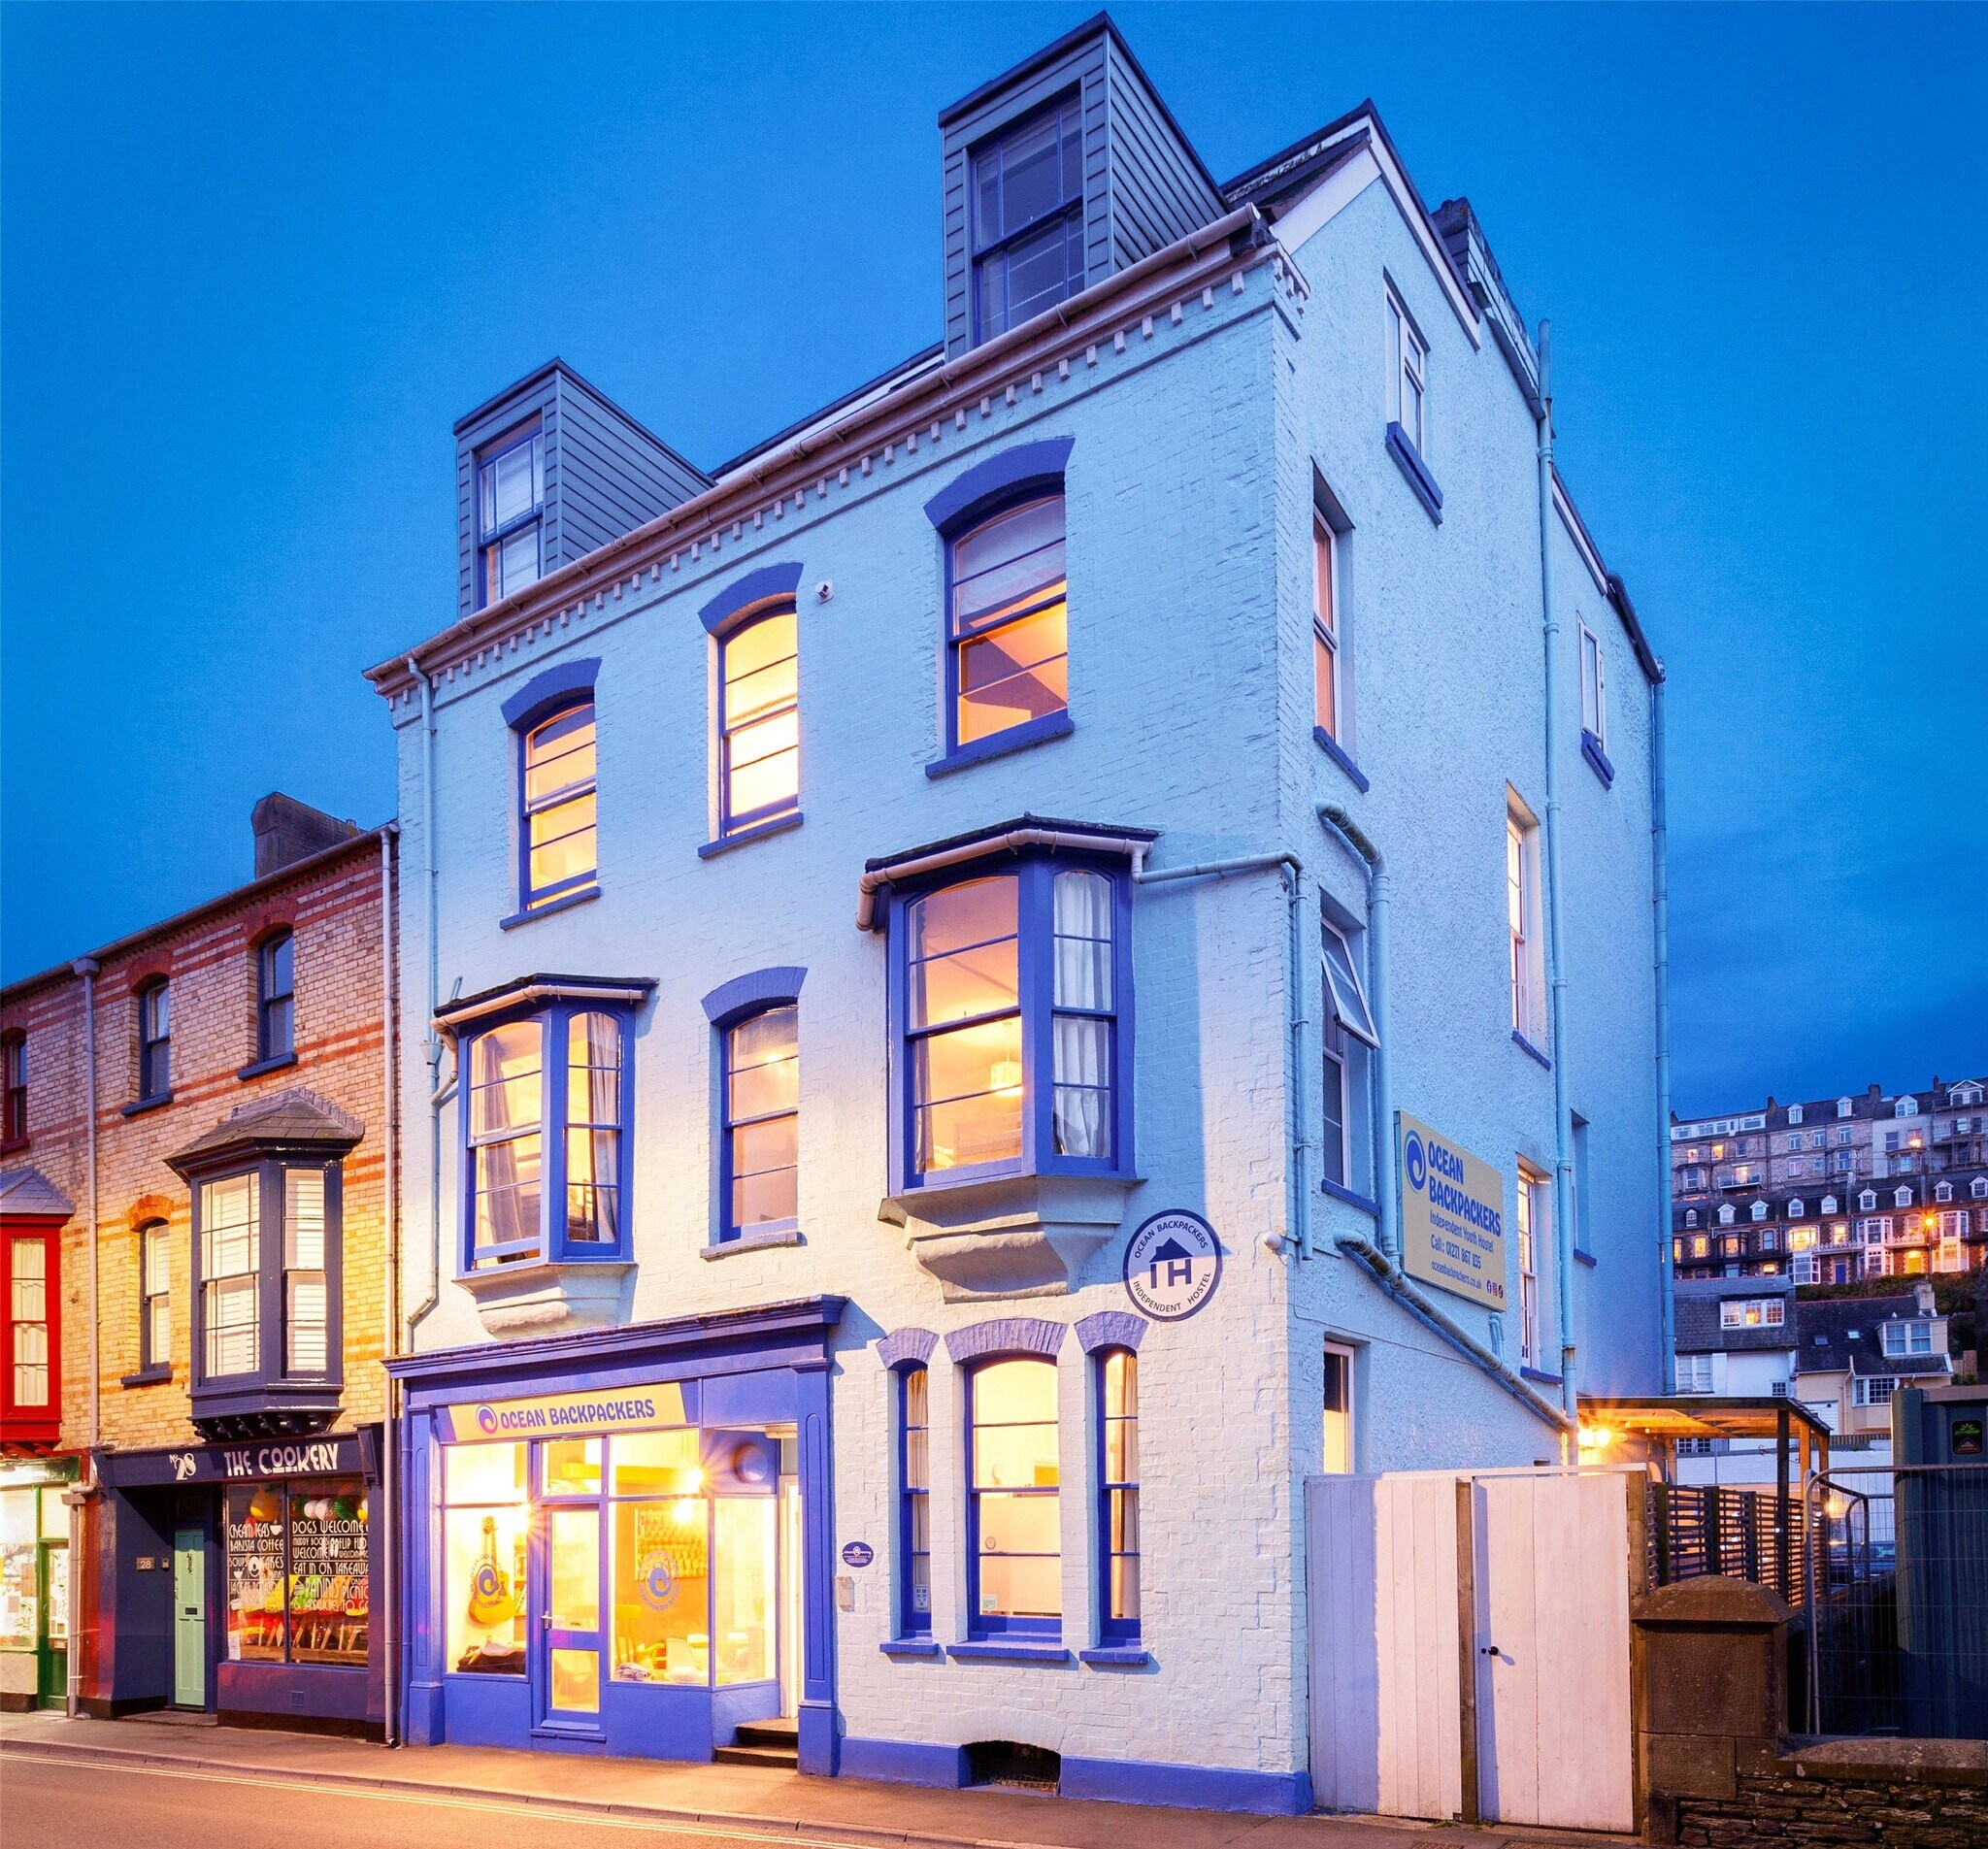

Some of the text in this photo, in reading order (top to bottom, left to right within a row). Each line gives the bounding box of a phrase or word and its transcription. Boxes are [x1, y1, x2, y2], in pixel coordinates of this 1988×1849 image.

[1428, 1140, 1464, 1185] OCEAN
[1429, 1175, 1501, 1238] BACKPACKERS
[1134, 1220, 1209, 1259] OCEAN BACKPACKERS
[1430, 1209, 1493, 1253] Independent Youth Hostel
[1431, 1261, 1481, 1290] oceanbackpackers.co.uk
[1133, 1271, 1211, 1312] INDEPENDENT HOSTEL
[501, 1399, 655, 1430] OCEAN BACKPACKERS
[175, 1453, 196, 1480] 28
[223, 1443, 339, 1476] THE COOKERY
[229, 1522, 270, 1538] CREAM TEAS
[292, 1520, 364, 1534] DOGS WELCOME
[229, 1538, 283, 1552] BARISTA COFFEE
[293, 1546, 328, 1559] WELCOME
[311, 1536, 329, 1546] BOOS
[339, 1537, 351, 1550] FLIP
[140, 1560, 151, 1568] 28
[293, 1562, 306, 1574] EAT
[309, 1563, 316, 1574] IN
[318, 1562, 332, 1574] OR
